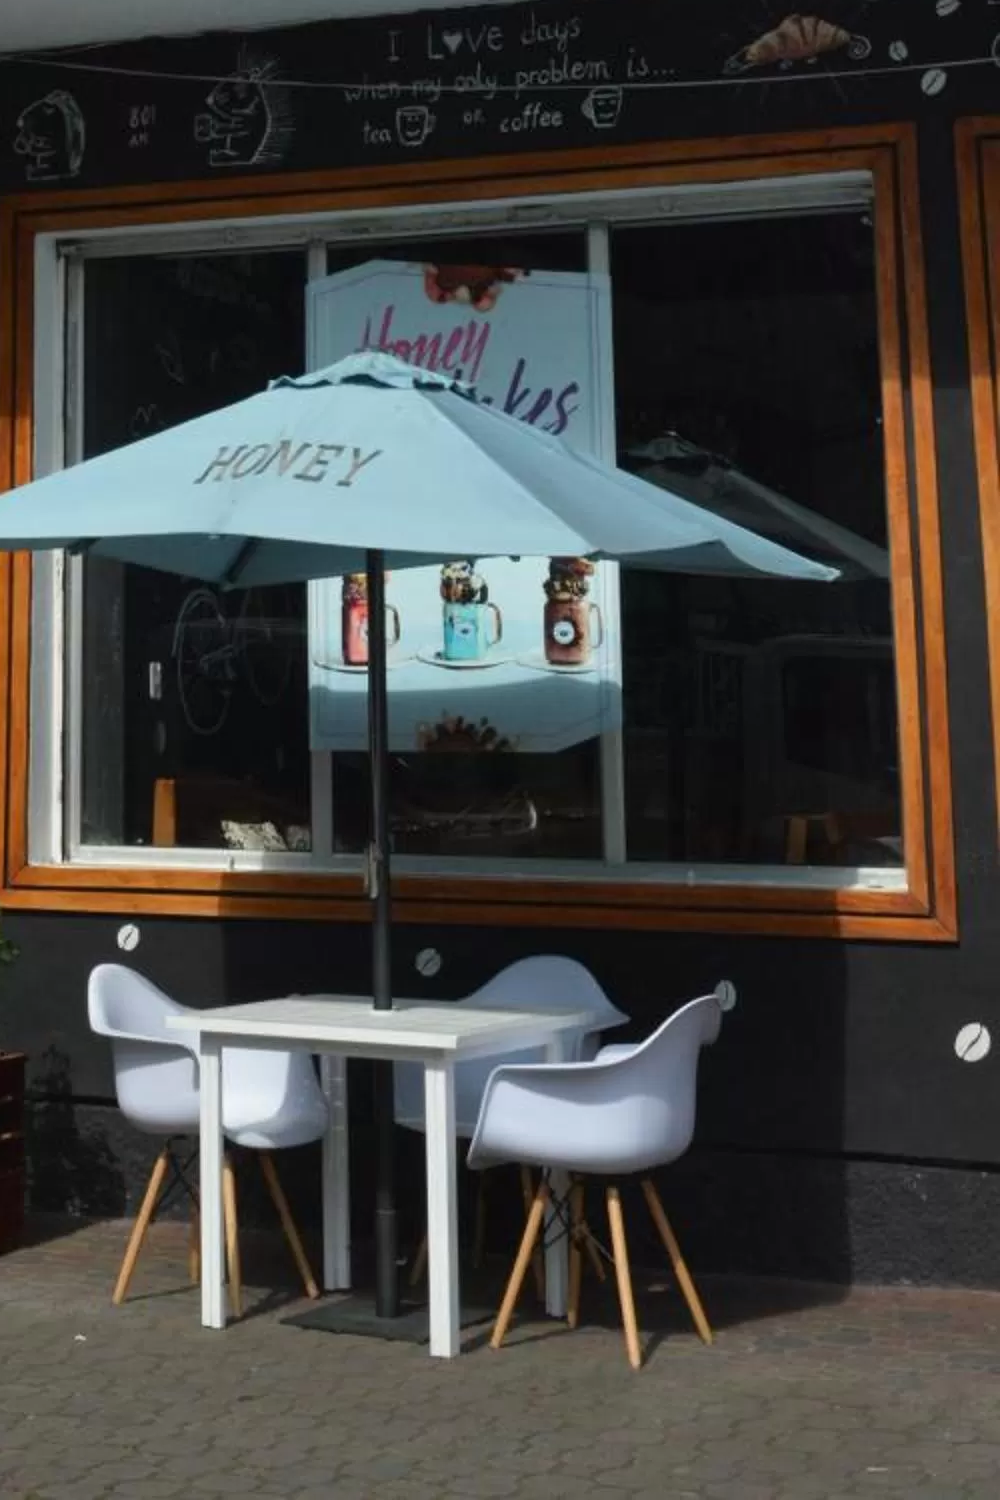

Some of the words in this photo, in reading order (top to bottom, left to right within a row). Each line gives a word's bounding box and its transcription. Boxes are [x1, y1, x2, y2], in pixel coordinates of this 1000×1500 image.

[386, 30, 404, 62] I
[520, 11, 581, 51] days
[344, 73, 400, 102] when
[411, 76, 441, 103] my
[515, 55, 611, 100] problem
[361, 120, 391, 145] tea
[499, 102, 565, 134] coffee
[193, 438, 385, 487] HONEY
